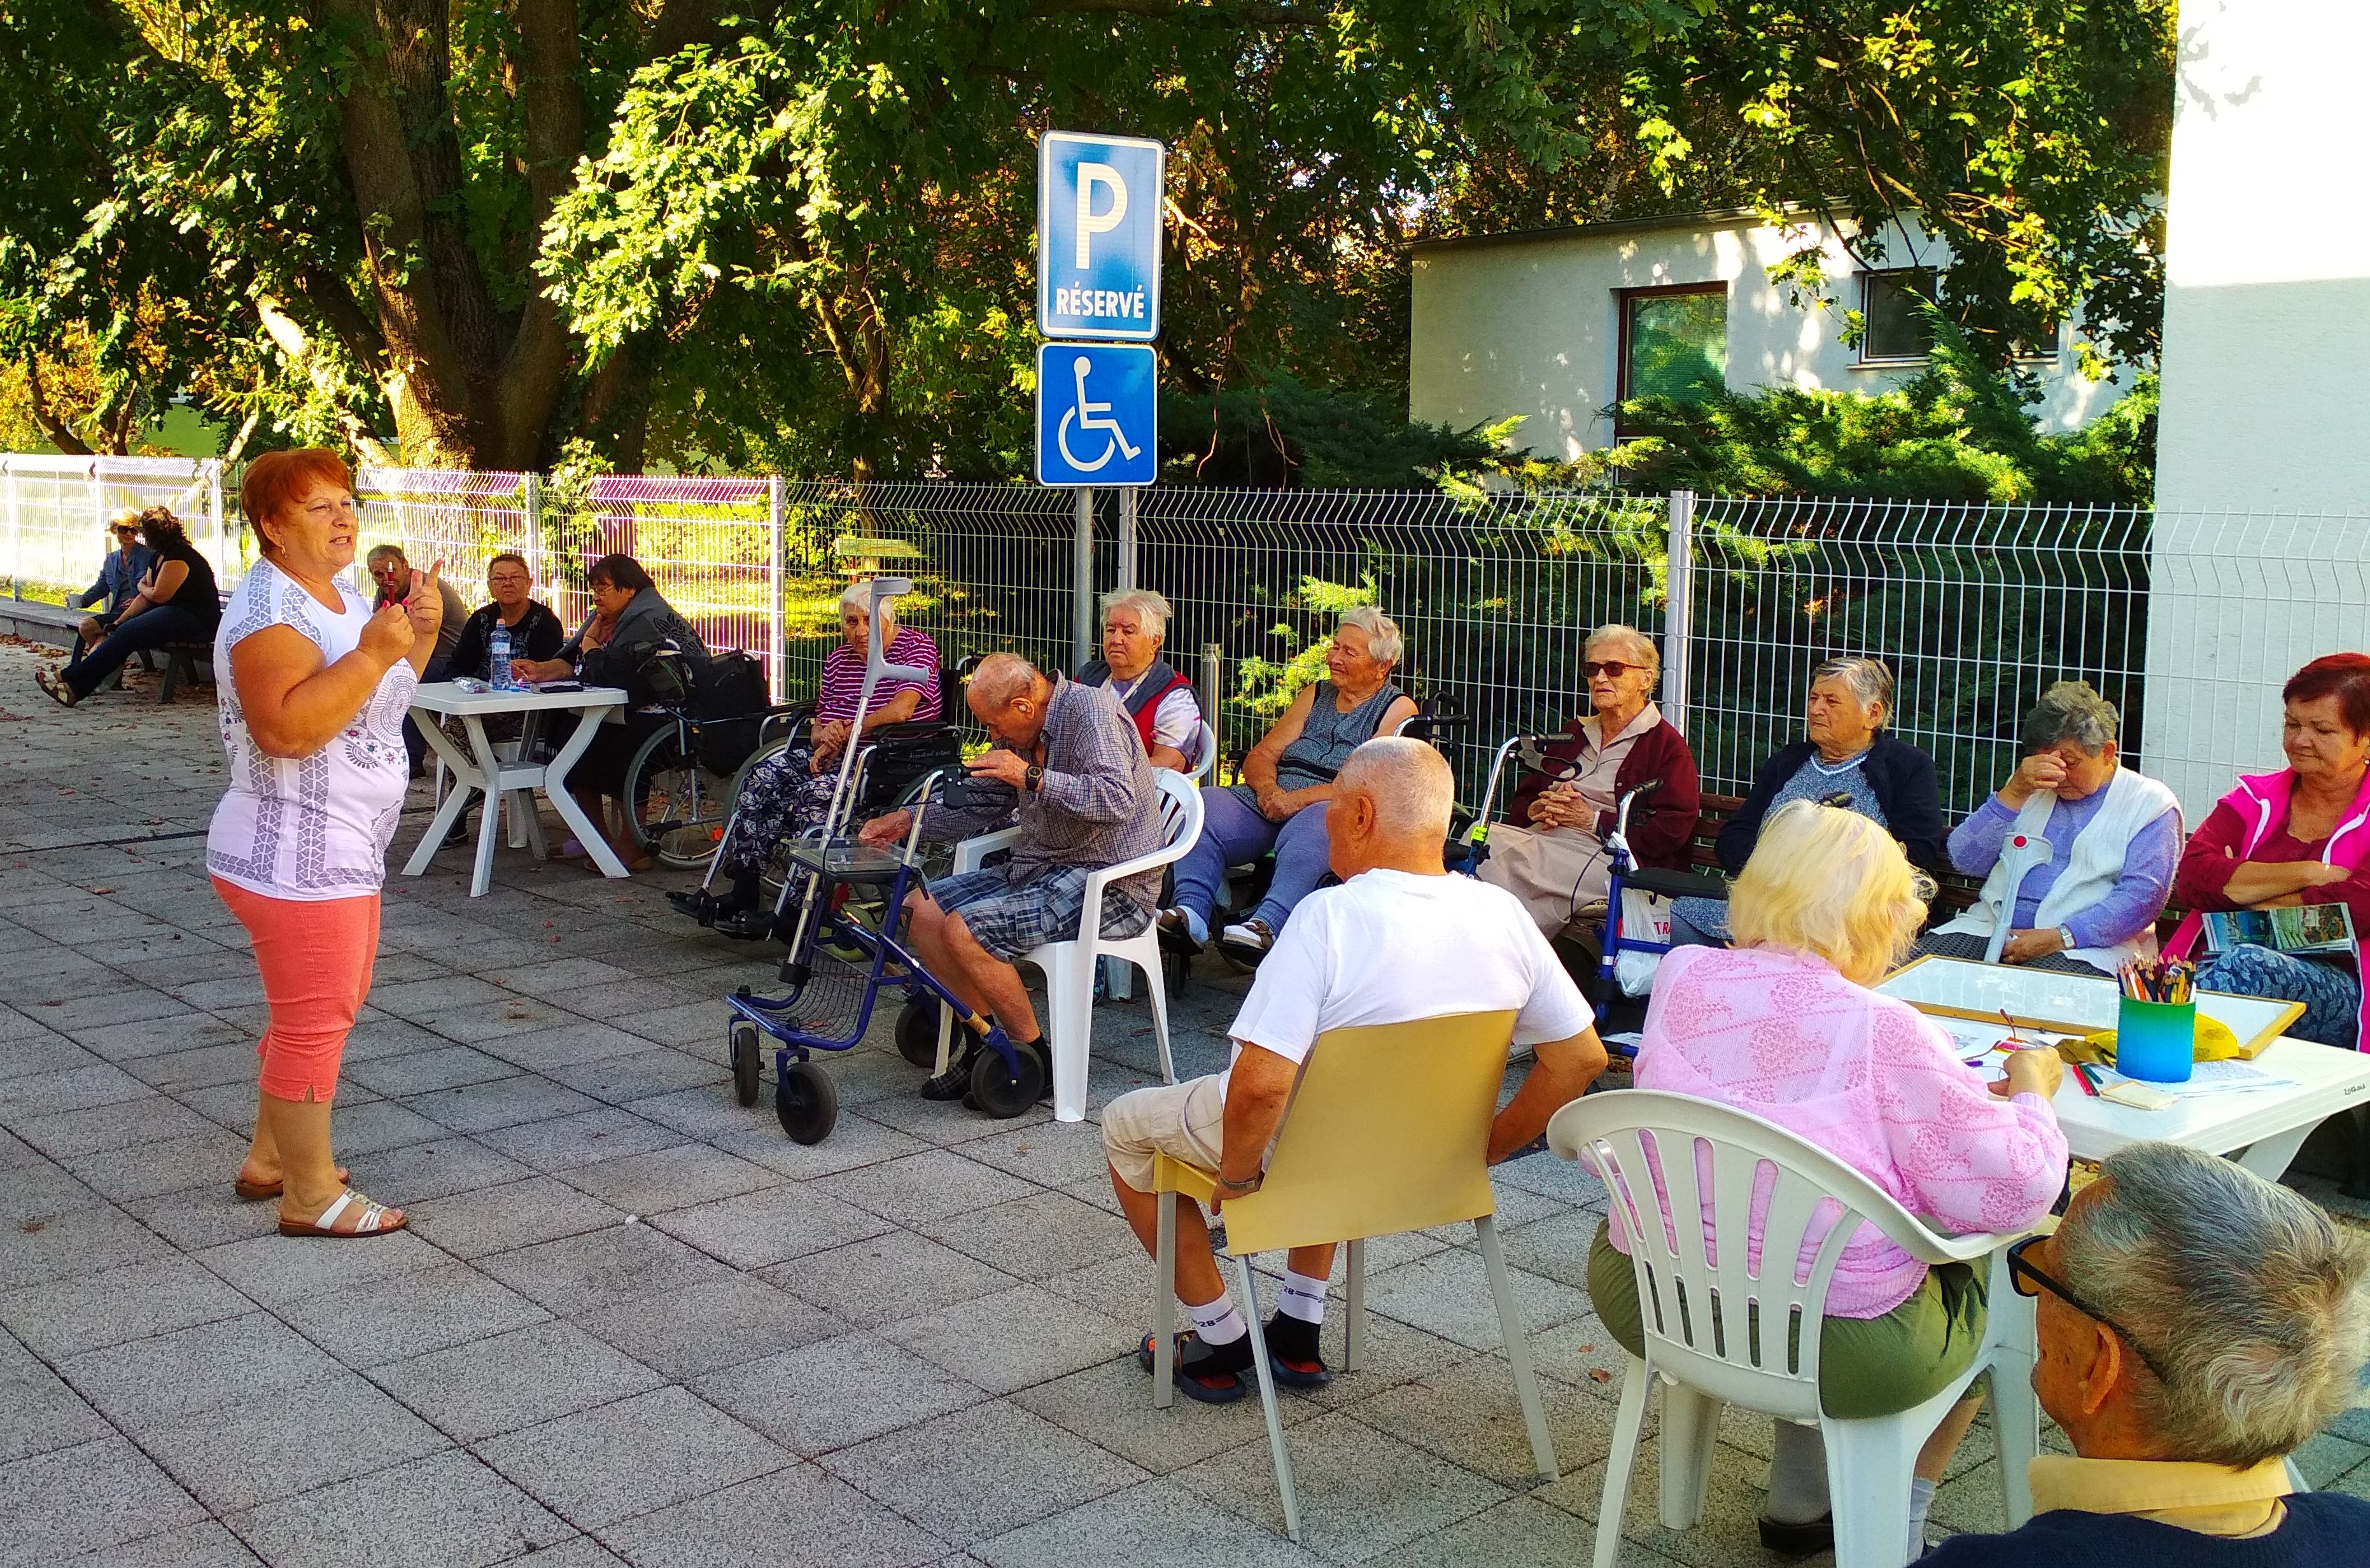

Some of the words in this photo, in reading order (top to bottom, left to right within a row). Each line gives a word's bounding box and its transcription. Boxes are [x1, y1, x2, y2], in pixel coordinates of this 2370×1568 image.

[1076, 162, 1128, 269] P
[1056, 281, 1144, 319] RÉSERVÉ
[1653, 921, 1671, 935] TR
[1283, 1285, 1294, 1295] 28
